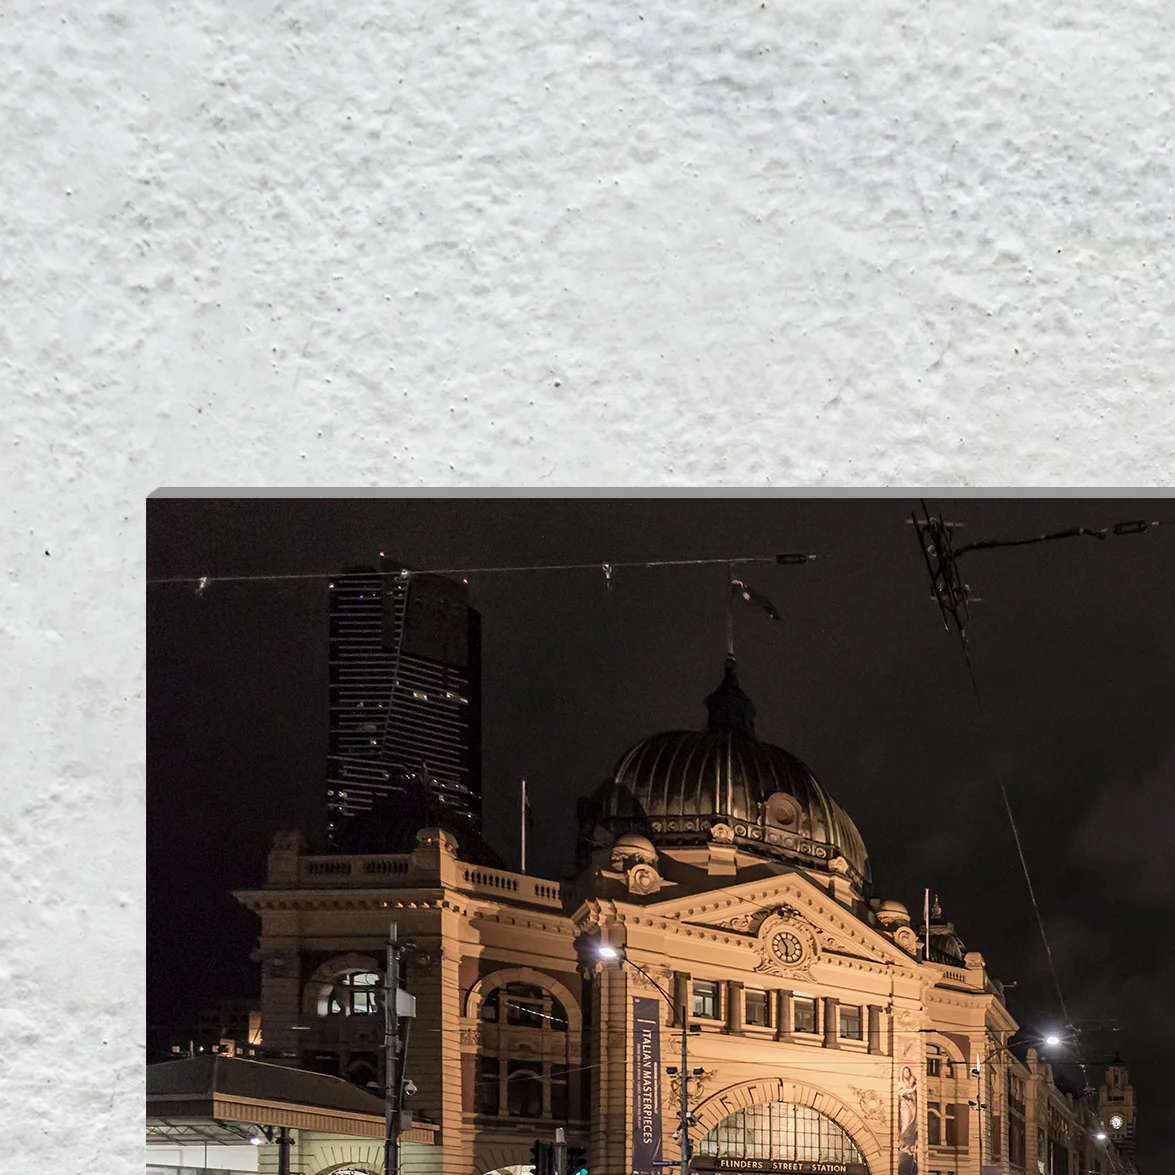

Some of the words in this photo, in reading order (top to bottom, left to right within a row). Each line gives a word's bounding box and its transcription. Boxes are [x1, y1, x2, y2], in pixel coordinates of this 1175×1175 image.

[642, 1029, 652, 1068] ITALIAN
[642, 1070, 653, 1144] MASTERPIECES
[720, 1159, 763, 1169] FLINDERS
[772, 1161, 803, 1171] STREET
[811, 1164, 847, 1173] STATION
